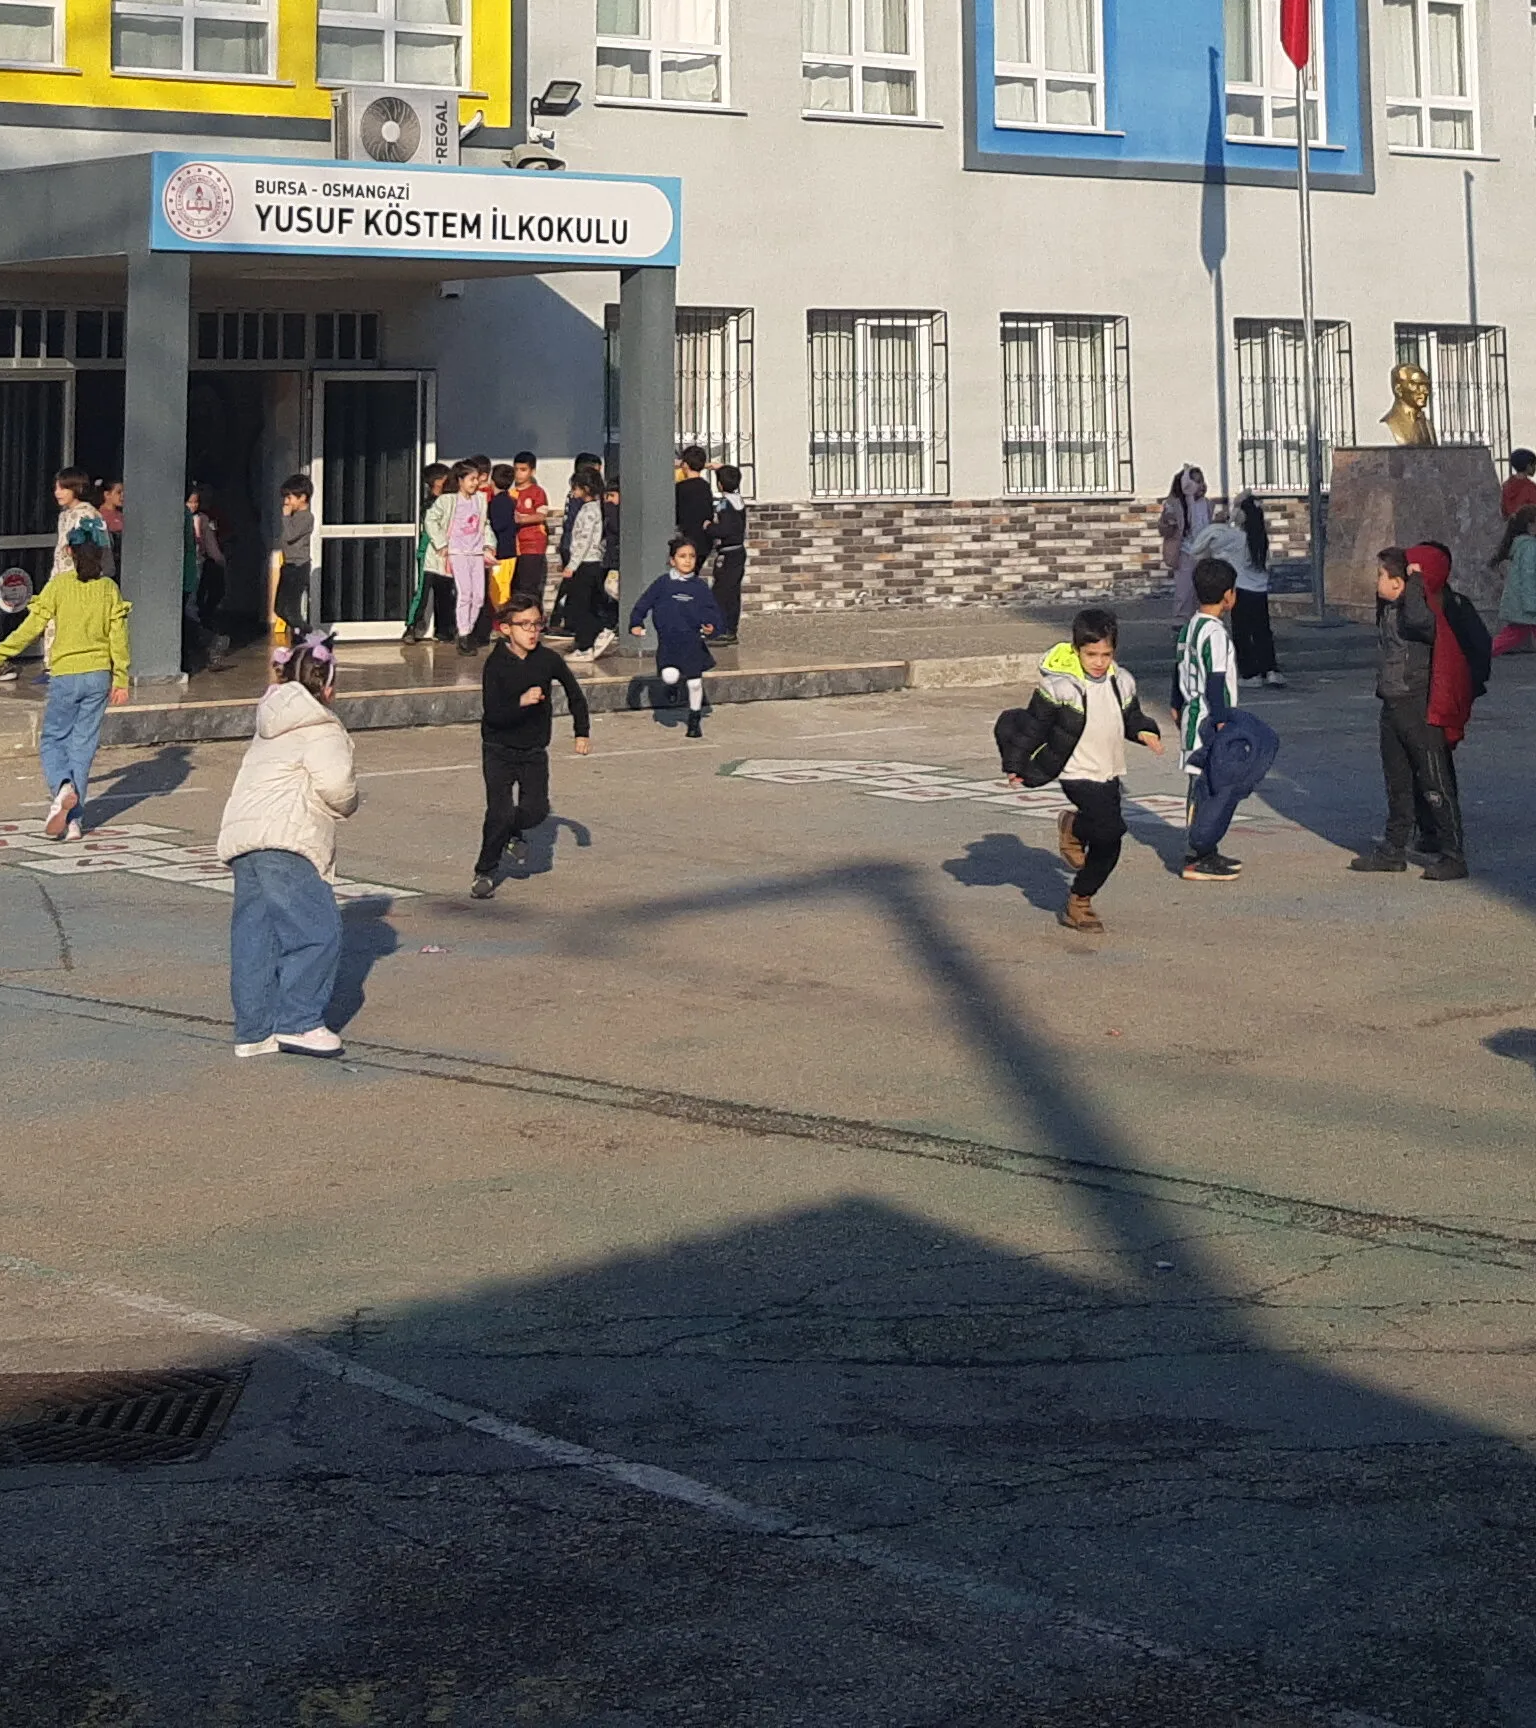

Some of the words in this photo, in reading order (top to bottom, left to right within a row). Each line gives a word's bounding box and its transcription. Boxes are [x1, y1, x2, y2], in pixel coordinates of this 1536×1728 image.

[436, 100, 448, 159] REGAL
[254, 179, 308, 198] BURSA
[322, 182, 410, 201] OSMANGAZİ
[254, 204, 355, 236] YUSUF
[363, 202, 482, 241] KÖSTEM
[490, 207, 629, 245] İLKOKULU
